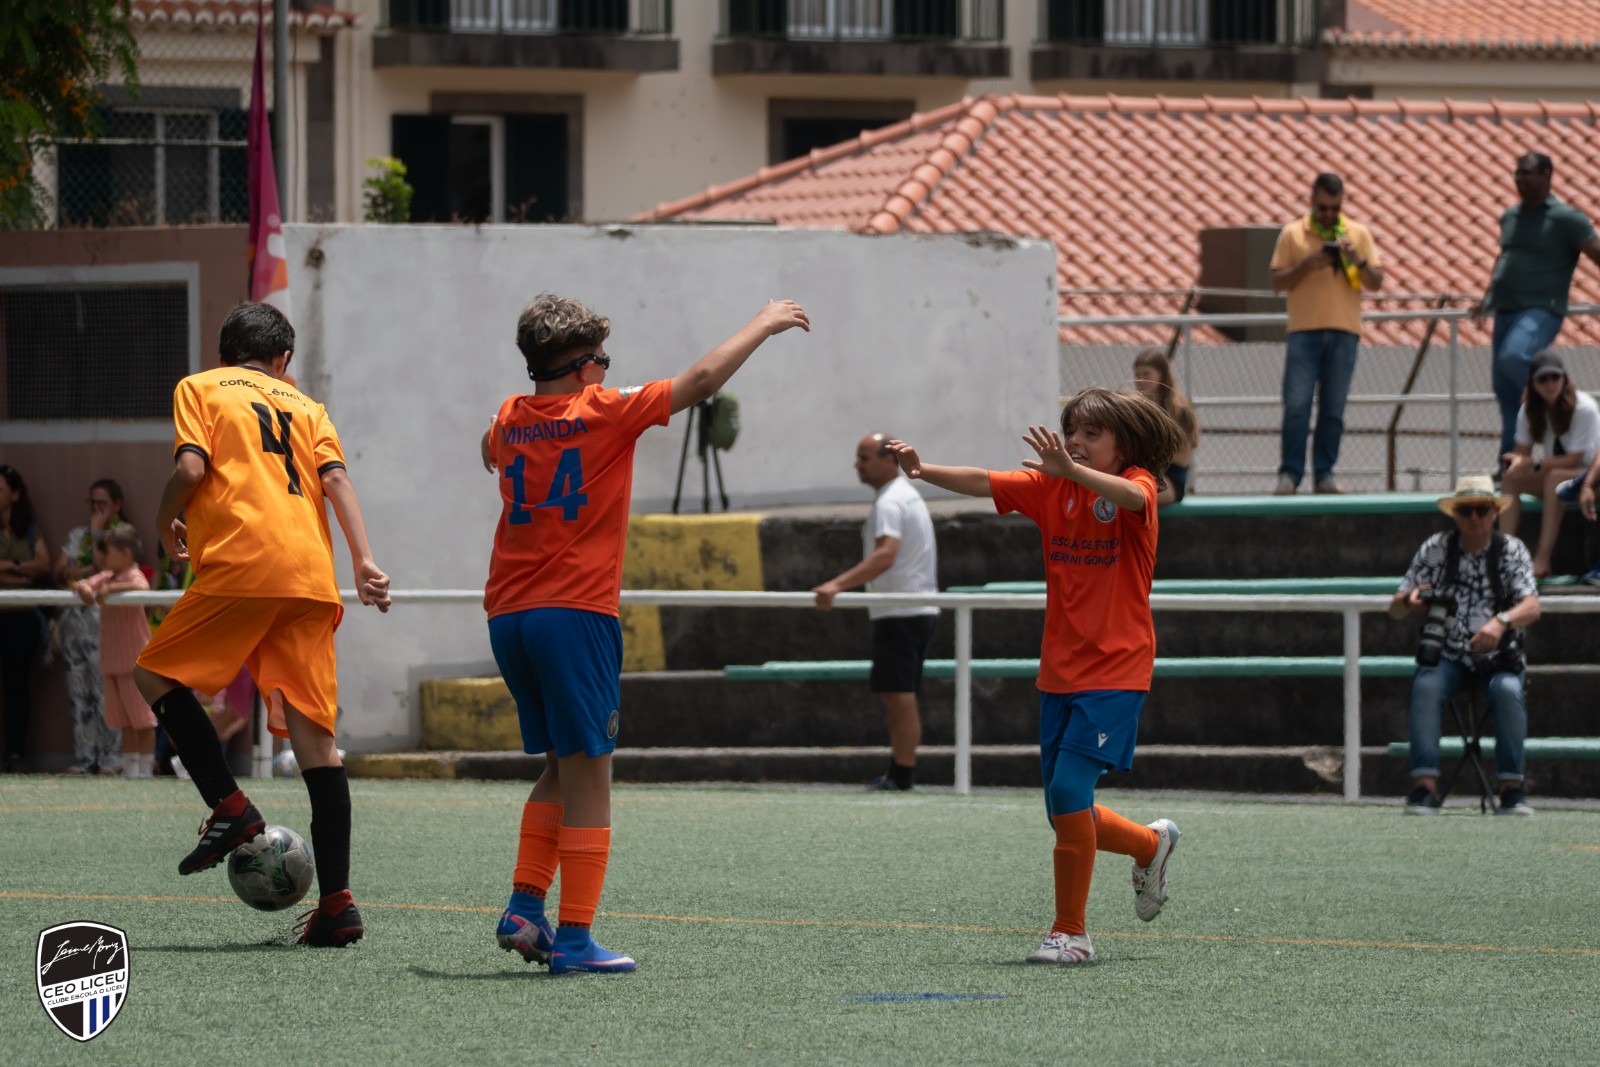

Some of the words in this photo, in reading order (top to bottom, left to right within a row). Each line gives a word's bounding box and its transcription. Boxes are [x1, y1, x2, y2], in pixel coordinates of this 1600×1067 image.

[250, 401, 304, 498] 4
[501, 417, 589, 446] MIRANDA
[505, 447, 588, 525] 14
[1081, 539, 1093, 550] DE
